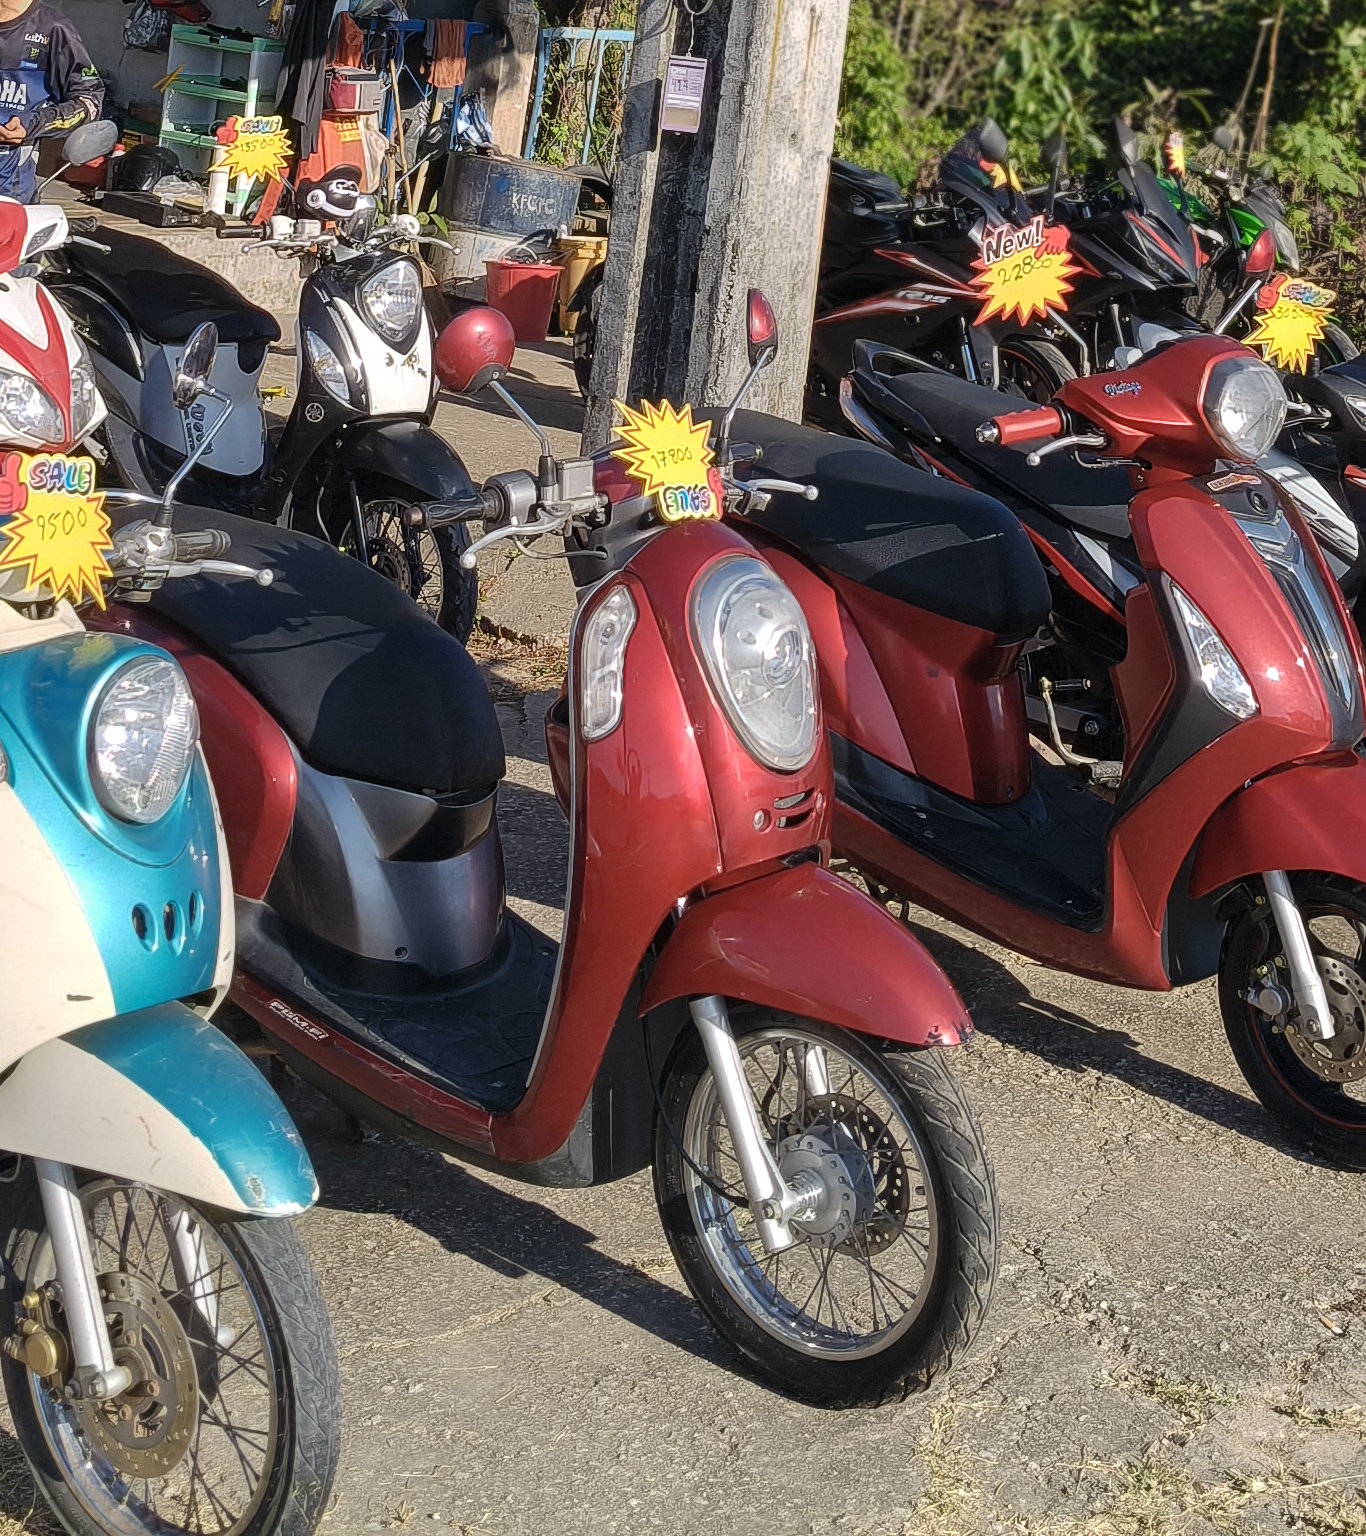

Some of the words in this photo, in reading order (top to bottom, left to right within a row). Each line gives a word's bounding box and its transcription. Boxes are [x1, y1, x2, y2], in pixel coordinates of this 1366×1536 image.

[240, 120, 280, 134] SALE
[984, 219, 1043, 264] New!
[29, 459, 92, 492] SALE
[36, 506, 87, 540] 9500
